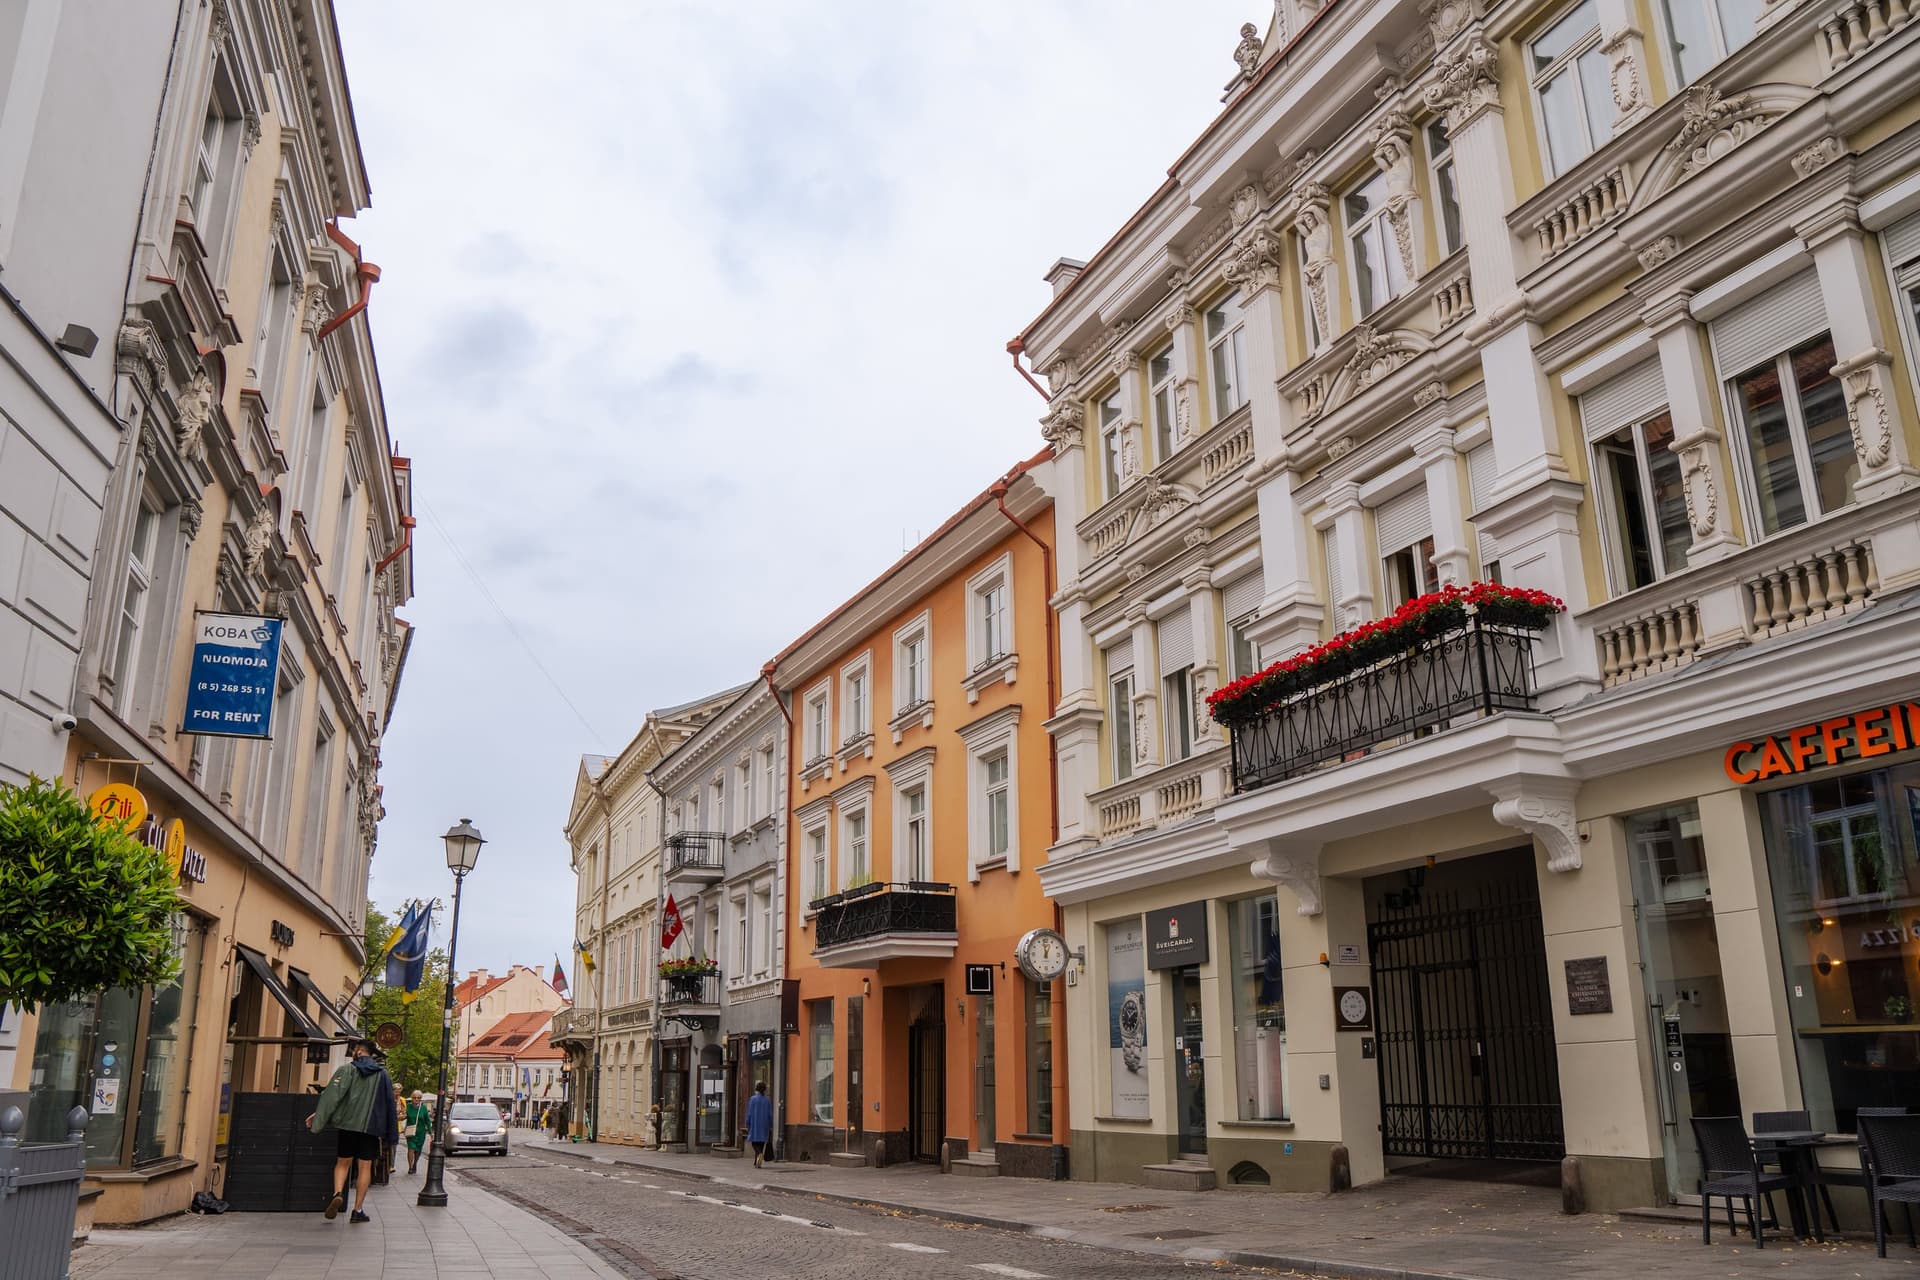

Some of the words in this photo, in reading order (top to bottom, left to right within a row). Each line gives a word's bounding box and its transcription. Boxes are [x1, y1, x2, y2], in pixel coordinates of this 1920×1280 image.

[204, 626, 249, 640] KOBA
[202, 654, 269, 668] NUOMOJA
[198, 681, 208, 692] (8
[209, 682, 219, 693] 5)
[221, 683, 239, 693] 268
[241, 685, 253, 694] 55
[256, 687, 266, 695] 11
[193, 709, 220, 720] FOR
[224, 711, 262, 723] RENT
[183, 845, 208, 883] PIZZA
[751, 1038, 771, 1054] iki
